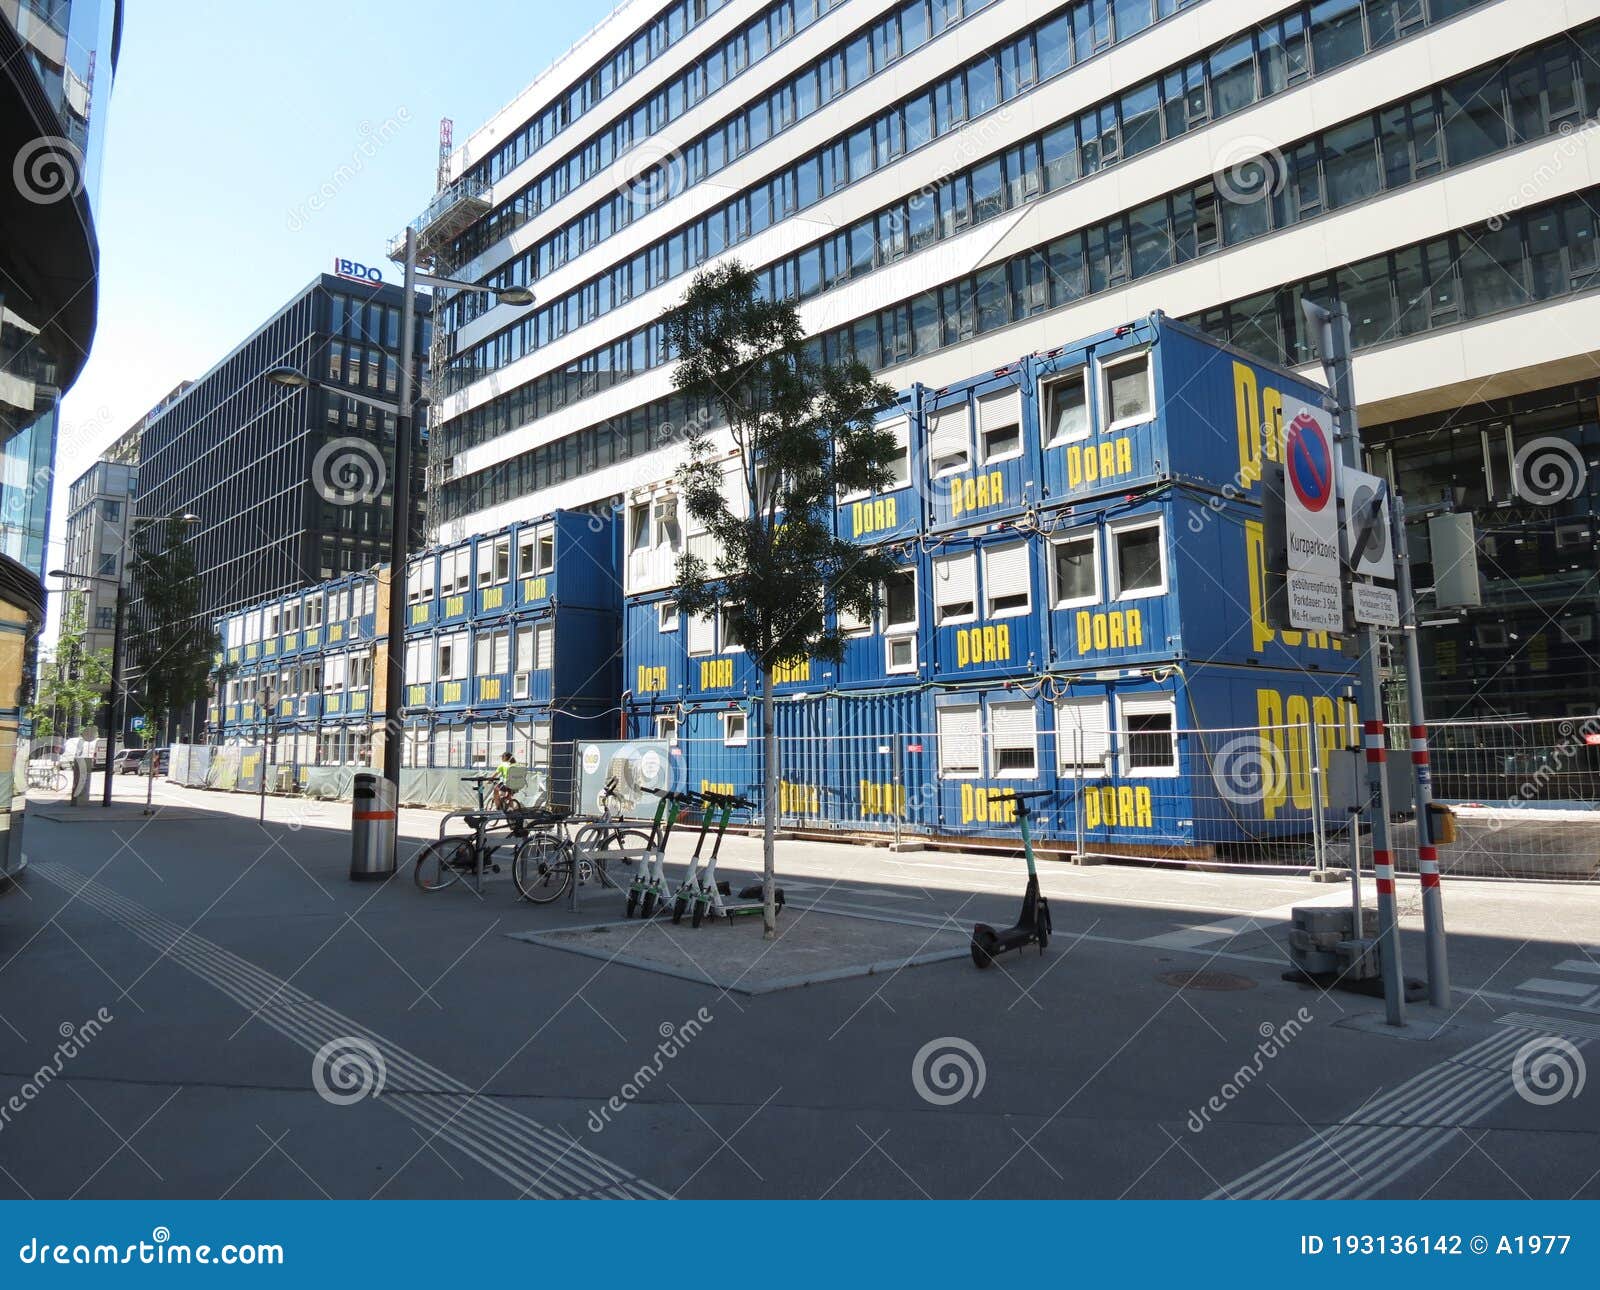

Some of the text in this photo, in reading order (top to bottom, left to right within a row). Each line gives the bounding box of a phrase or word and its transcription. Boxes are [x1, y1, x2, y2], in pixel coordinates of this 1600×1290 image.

[340, 258, 383, 282] BDO
[1067, 437, 1133, 489] PORR
[951, 471, 1004, 517] PORR
[852, 498, 897, 538] PORR
[1290, 531, 1337, 560] Kurzparkzone
[956, 624, 1010, 668] PORR
[1076, 609, 1143, 655] PORR
[700, 659, 733, 691] PORR
[961, 784, 1017, 824] PORR
[1084, 786, 1152, 829] PORR
